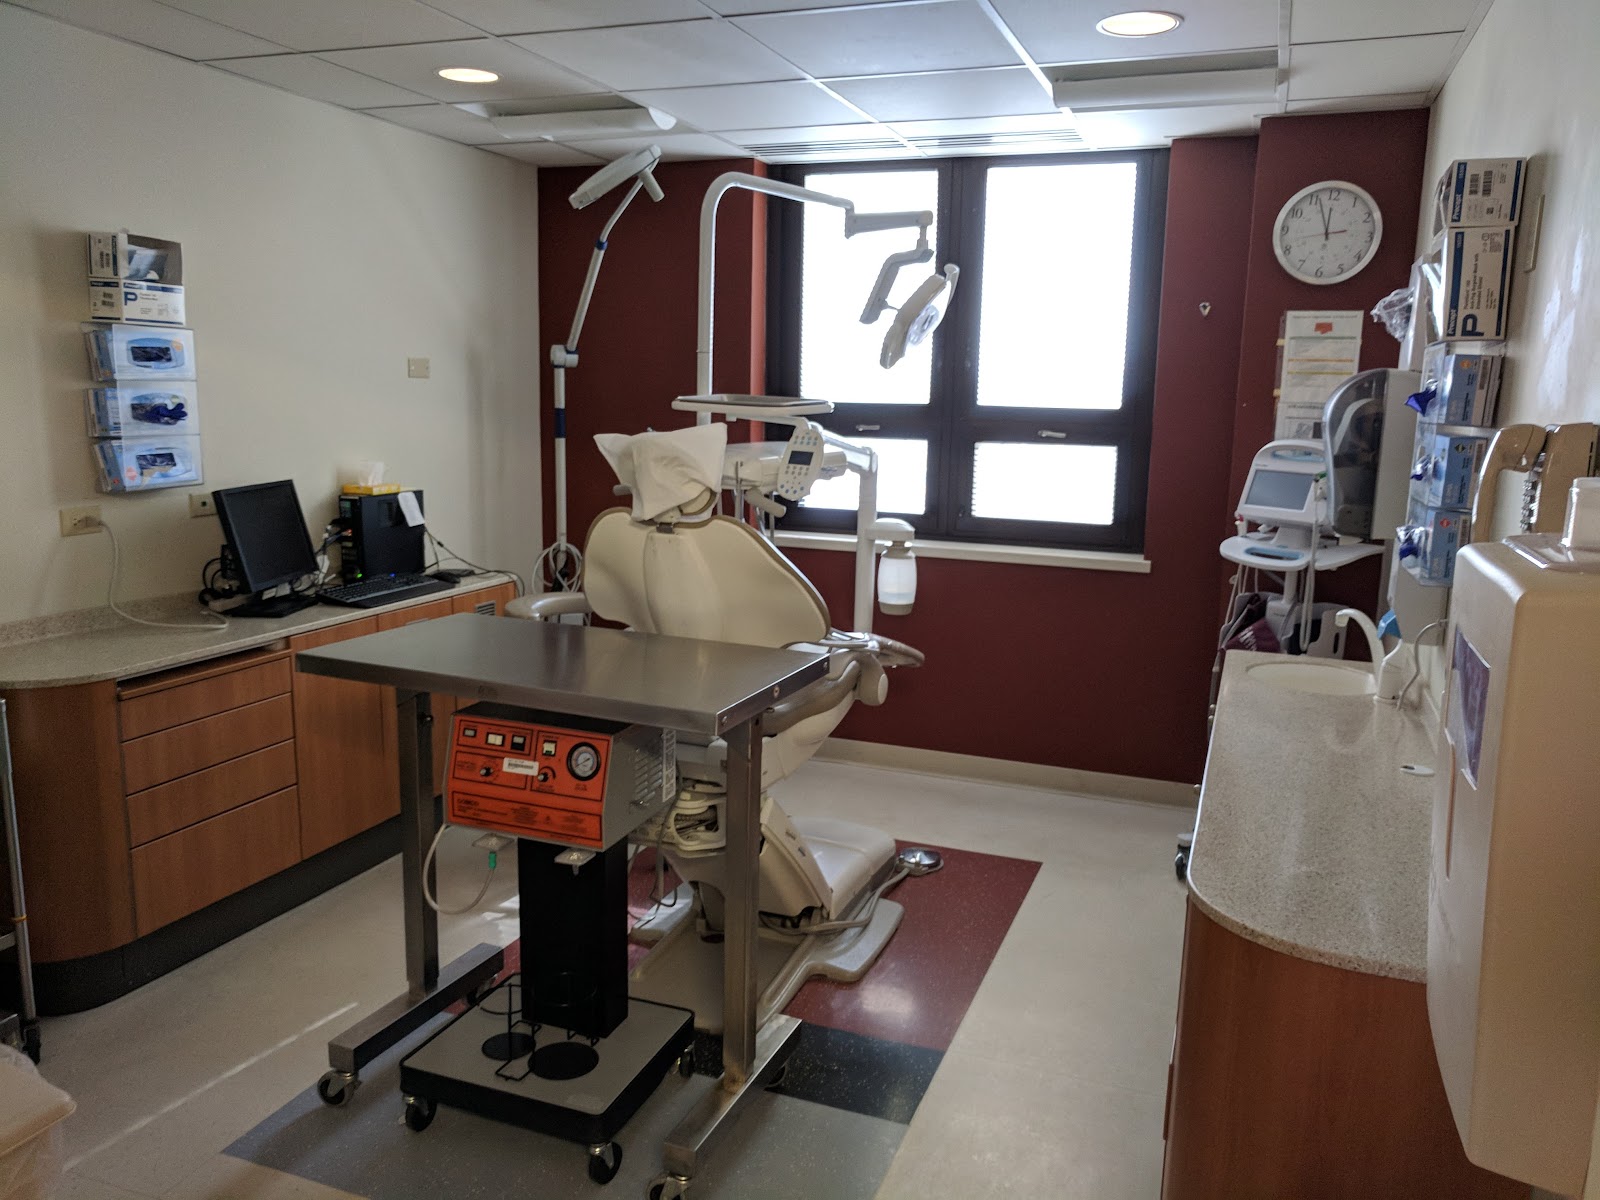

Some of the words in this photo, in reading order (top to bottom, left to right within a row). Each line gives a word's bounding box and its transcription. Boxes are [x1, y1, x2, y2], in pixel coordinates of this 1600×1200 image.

[1309, 194, 1318, 206] 11
[1328, 190, 1340, 201] 12
[1352, 197, 1358, 208] 1
[1453, 194, 1462, 220] Precept
[1291, 208, 1302, 219] 10
[1363, 212, 1372, 223] 2
[1281, 225, 1289, 236] 9
[1365, 232, 1373, 244] 3
[1284, 245, 1292, 256] 8
[1353, 250, 1362, 262] 4
[1298, 260, 1306, 271] 7
[1336, 264, 1344, 276] 5
[1315, 266, 1323, 278] 6
[124, 291, 138, 306] P
[1447, 309, 1457, 334] Precept
[1460, 314, 1484, 337] P
